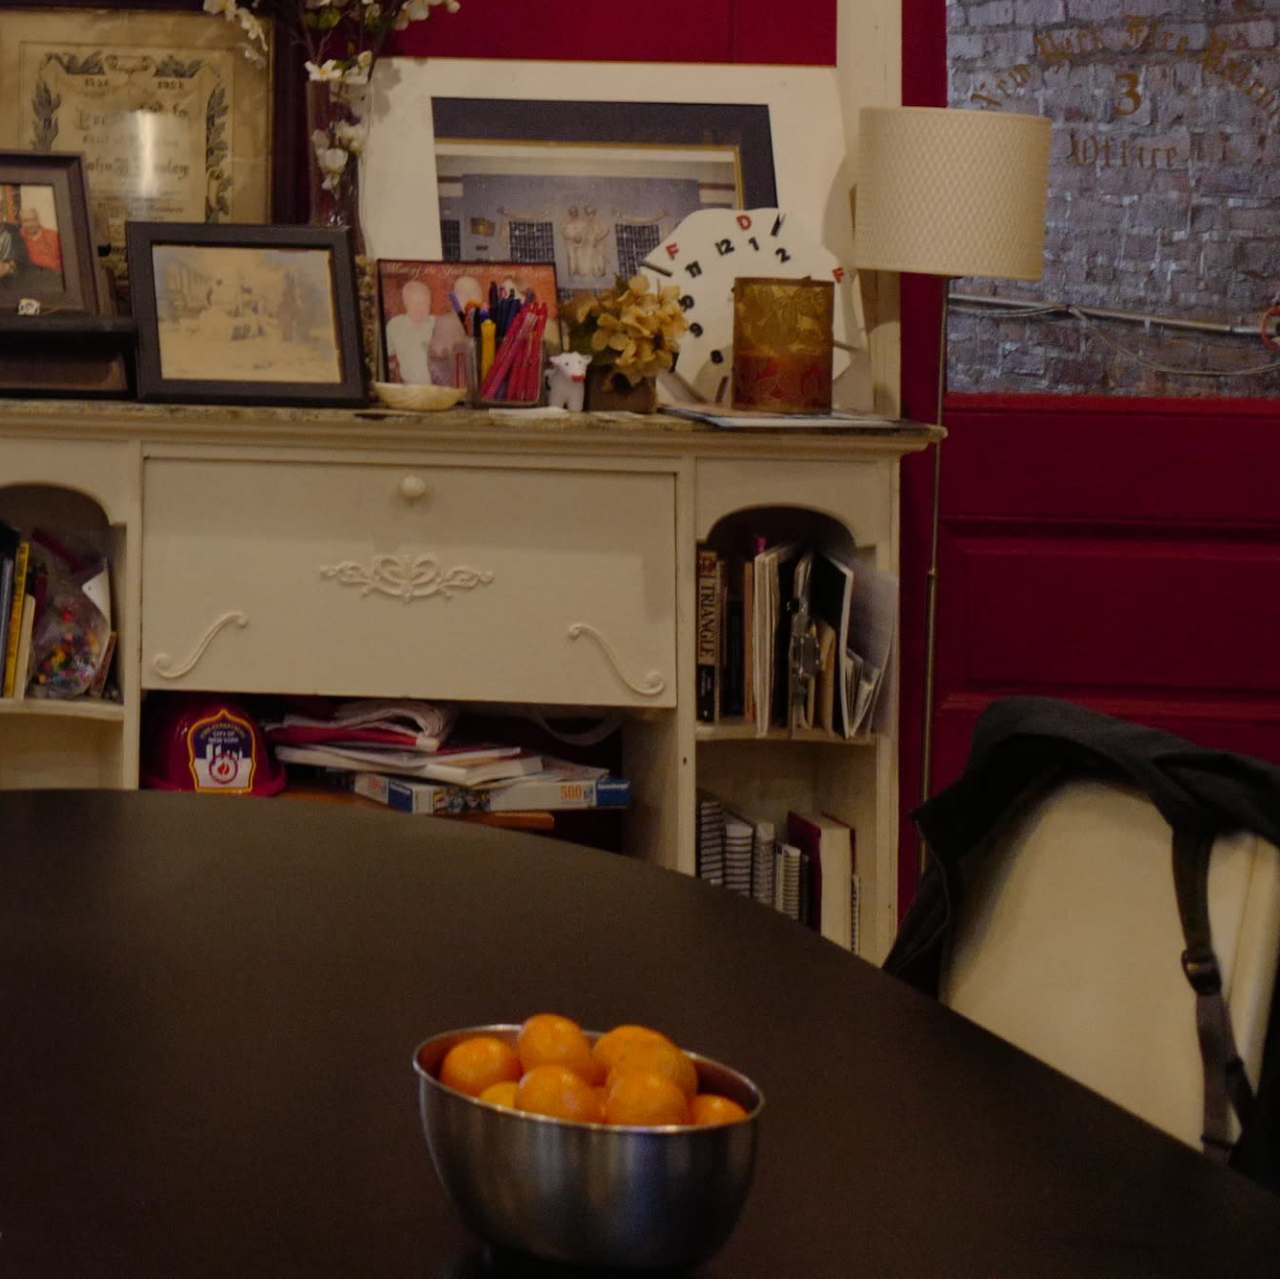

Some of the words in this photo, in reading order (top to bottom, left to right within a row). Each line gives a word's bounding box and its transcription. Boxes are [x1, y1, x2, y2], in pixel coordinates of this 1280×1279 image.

[1113, 70, 1143, 118] 3
[736, 214, 753, 231] D
[665, 242, 680, 261] F
[714, 238, 736, 256] 12
[774, 247, 791, 264] 2
[699, 582, 716, 658] TRIANGLE
[559, 784, 583, 801] 500
